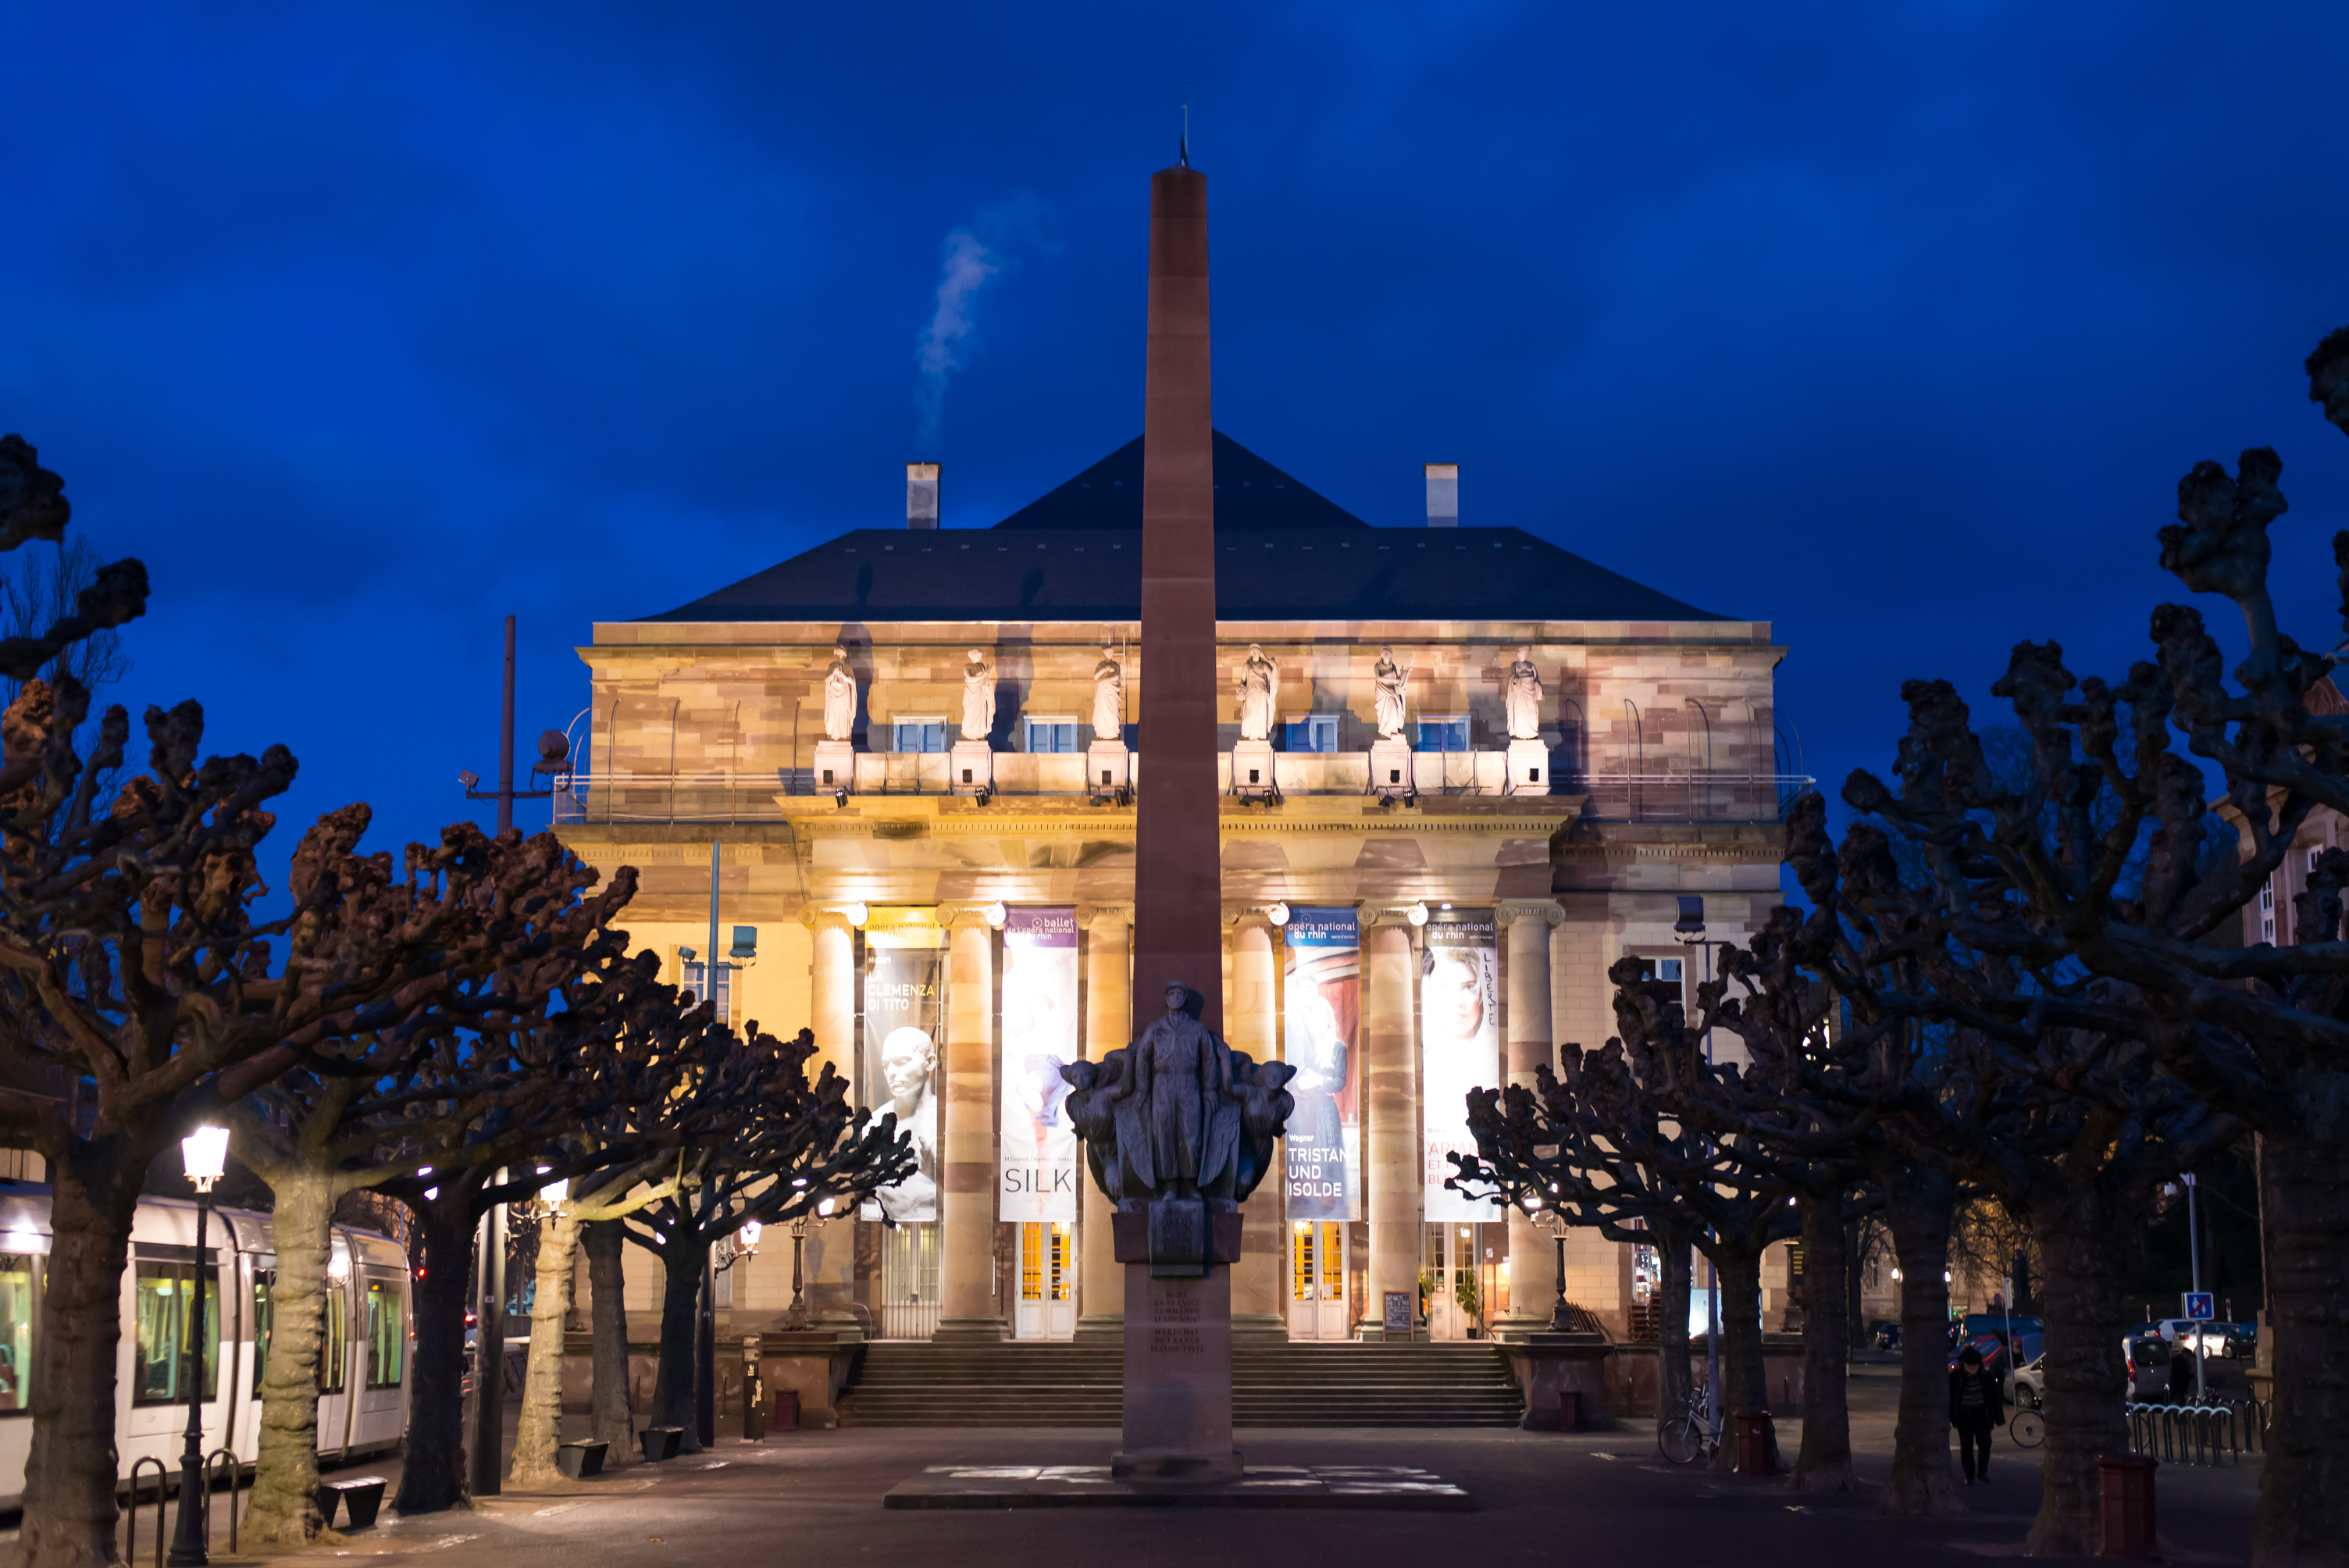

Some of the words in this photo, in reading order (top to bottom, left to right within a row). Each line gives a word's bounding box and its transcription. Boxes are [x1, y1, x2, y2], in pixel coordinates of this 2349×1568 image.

[1044, 918, 1074, 928] ballet
[1317, 921, 1356, 931] national
[1456, 921, 1494, 932] national
[1037, 932, 1052, 940] rhin
[1294, 928, 1305, 939] du
[1307, 928, 1327, 939] rhin
[1431, 929, 1443, 939] du
[1445, 929, 1464, 939] rhin
[868, 969, 883, 982] LA
[868, 984, 935, 996] CLEMENZA
[868, 999, 879, 1011] DI
[882, 999, 909, 1011] TITO
[1289, 1134, 1314, 1143] Wagner
[1429, 1142, 1479, 1156] ARIAN
[1288, 1148, 1350, 1163] TRISTAN
[1428, 1160, 1442, 1170] ET
[1289, 1165, 1321, 1179] UND
[1005, 1168, 1072, 1192] SILK
[1289, 1182, 1342, 1197] ISOLDE
